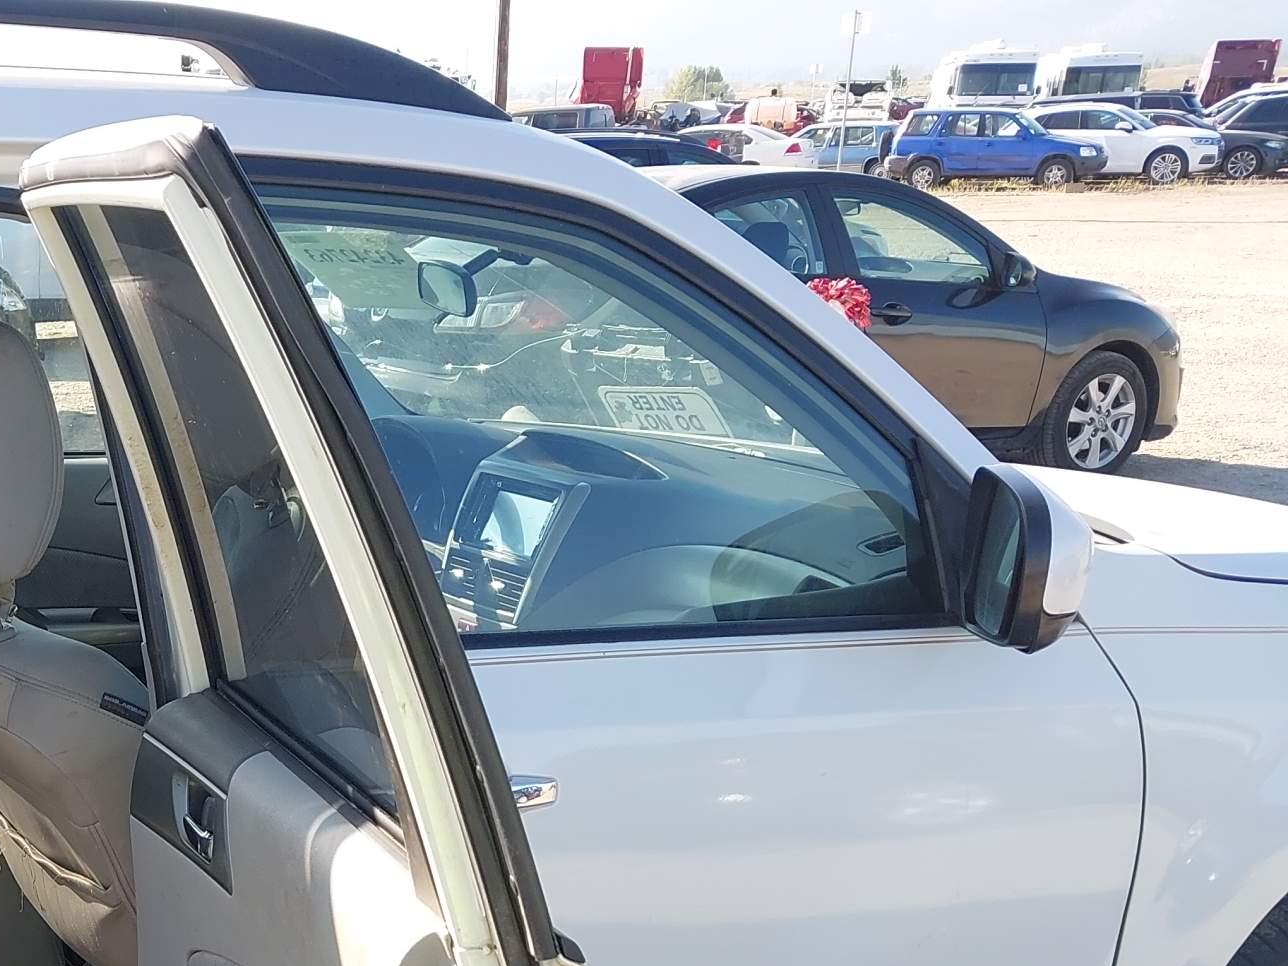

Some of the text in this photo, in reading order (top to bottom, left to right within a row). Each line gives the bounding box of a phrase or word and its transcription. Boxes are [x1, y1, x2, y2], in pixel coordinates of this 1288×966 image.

[627, 394, 686, 411] ENTER
[634, 413, 706, 431] DO NOT
